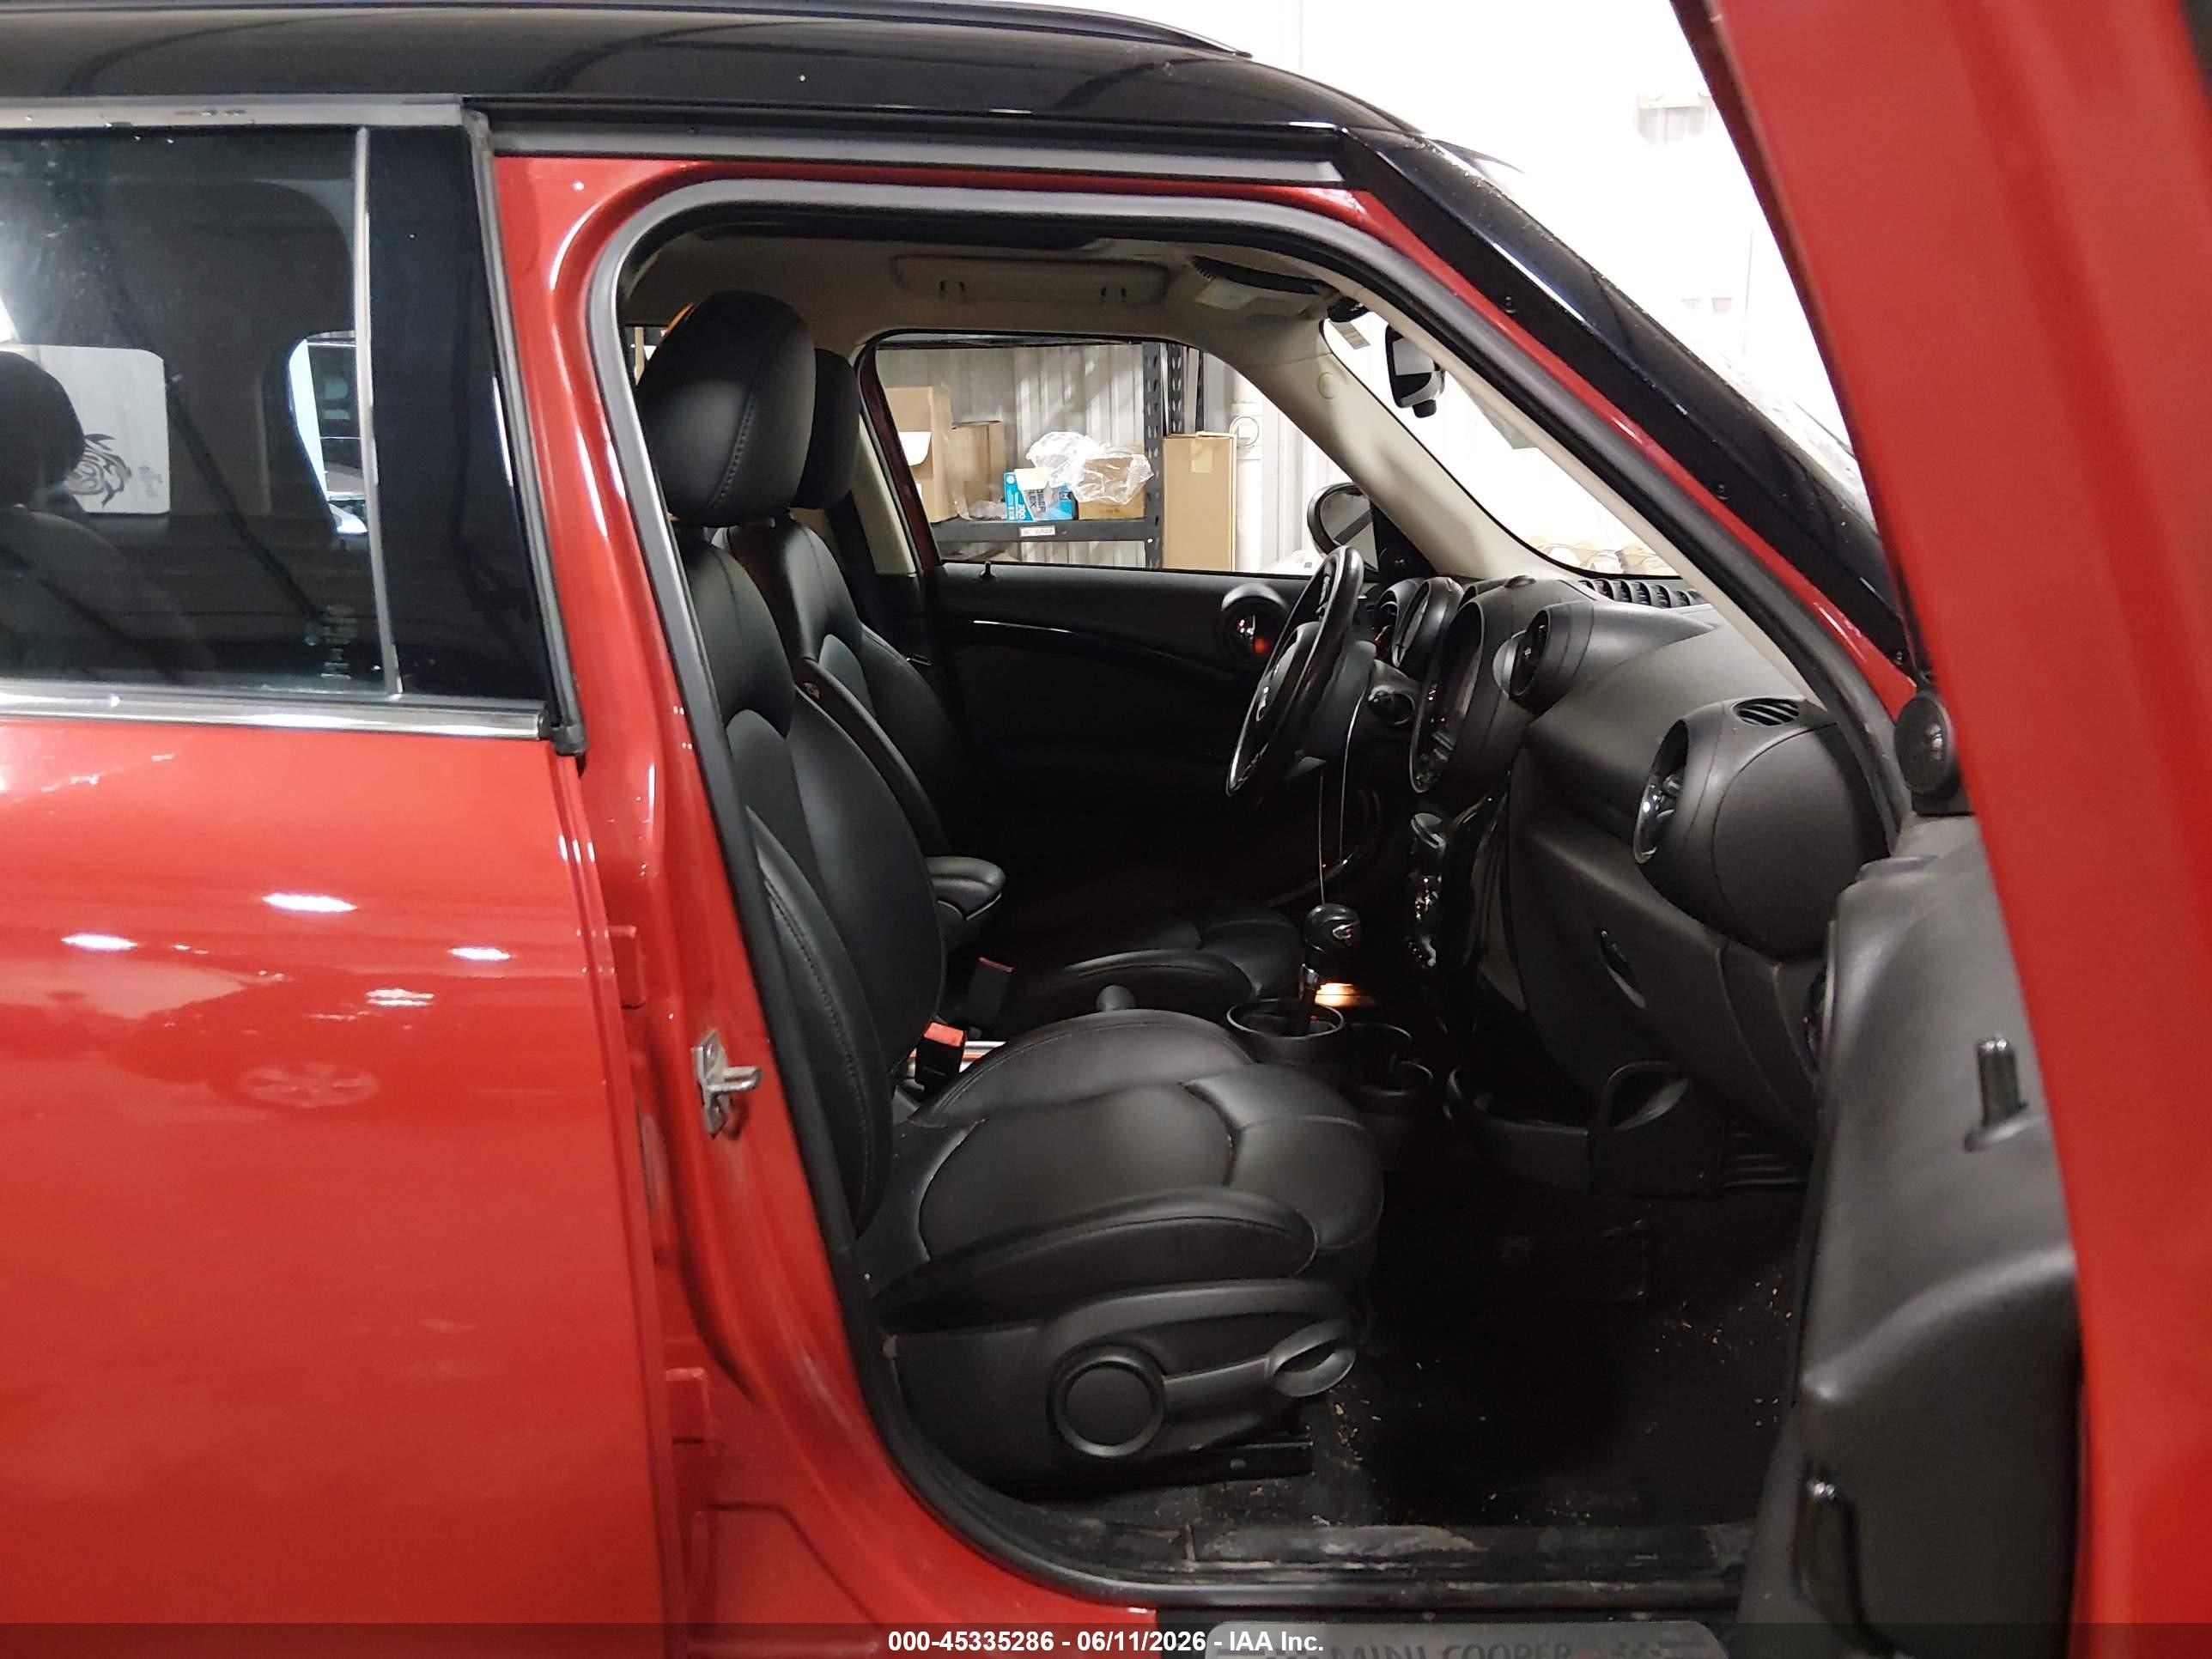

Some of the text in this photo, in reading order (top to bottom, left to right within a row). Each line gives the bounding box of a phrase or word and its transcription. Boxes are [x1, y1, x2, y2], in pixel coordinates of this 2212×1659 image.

[1036, 489, 1047, 513] OWER
[1331, 1644, 1427, 1659] MINI
[1441, 1644, 1572, 1659] COOPER
